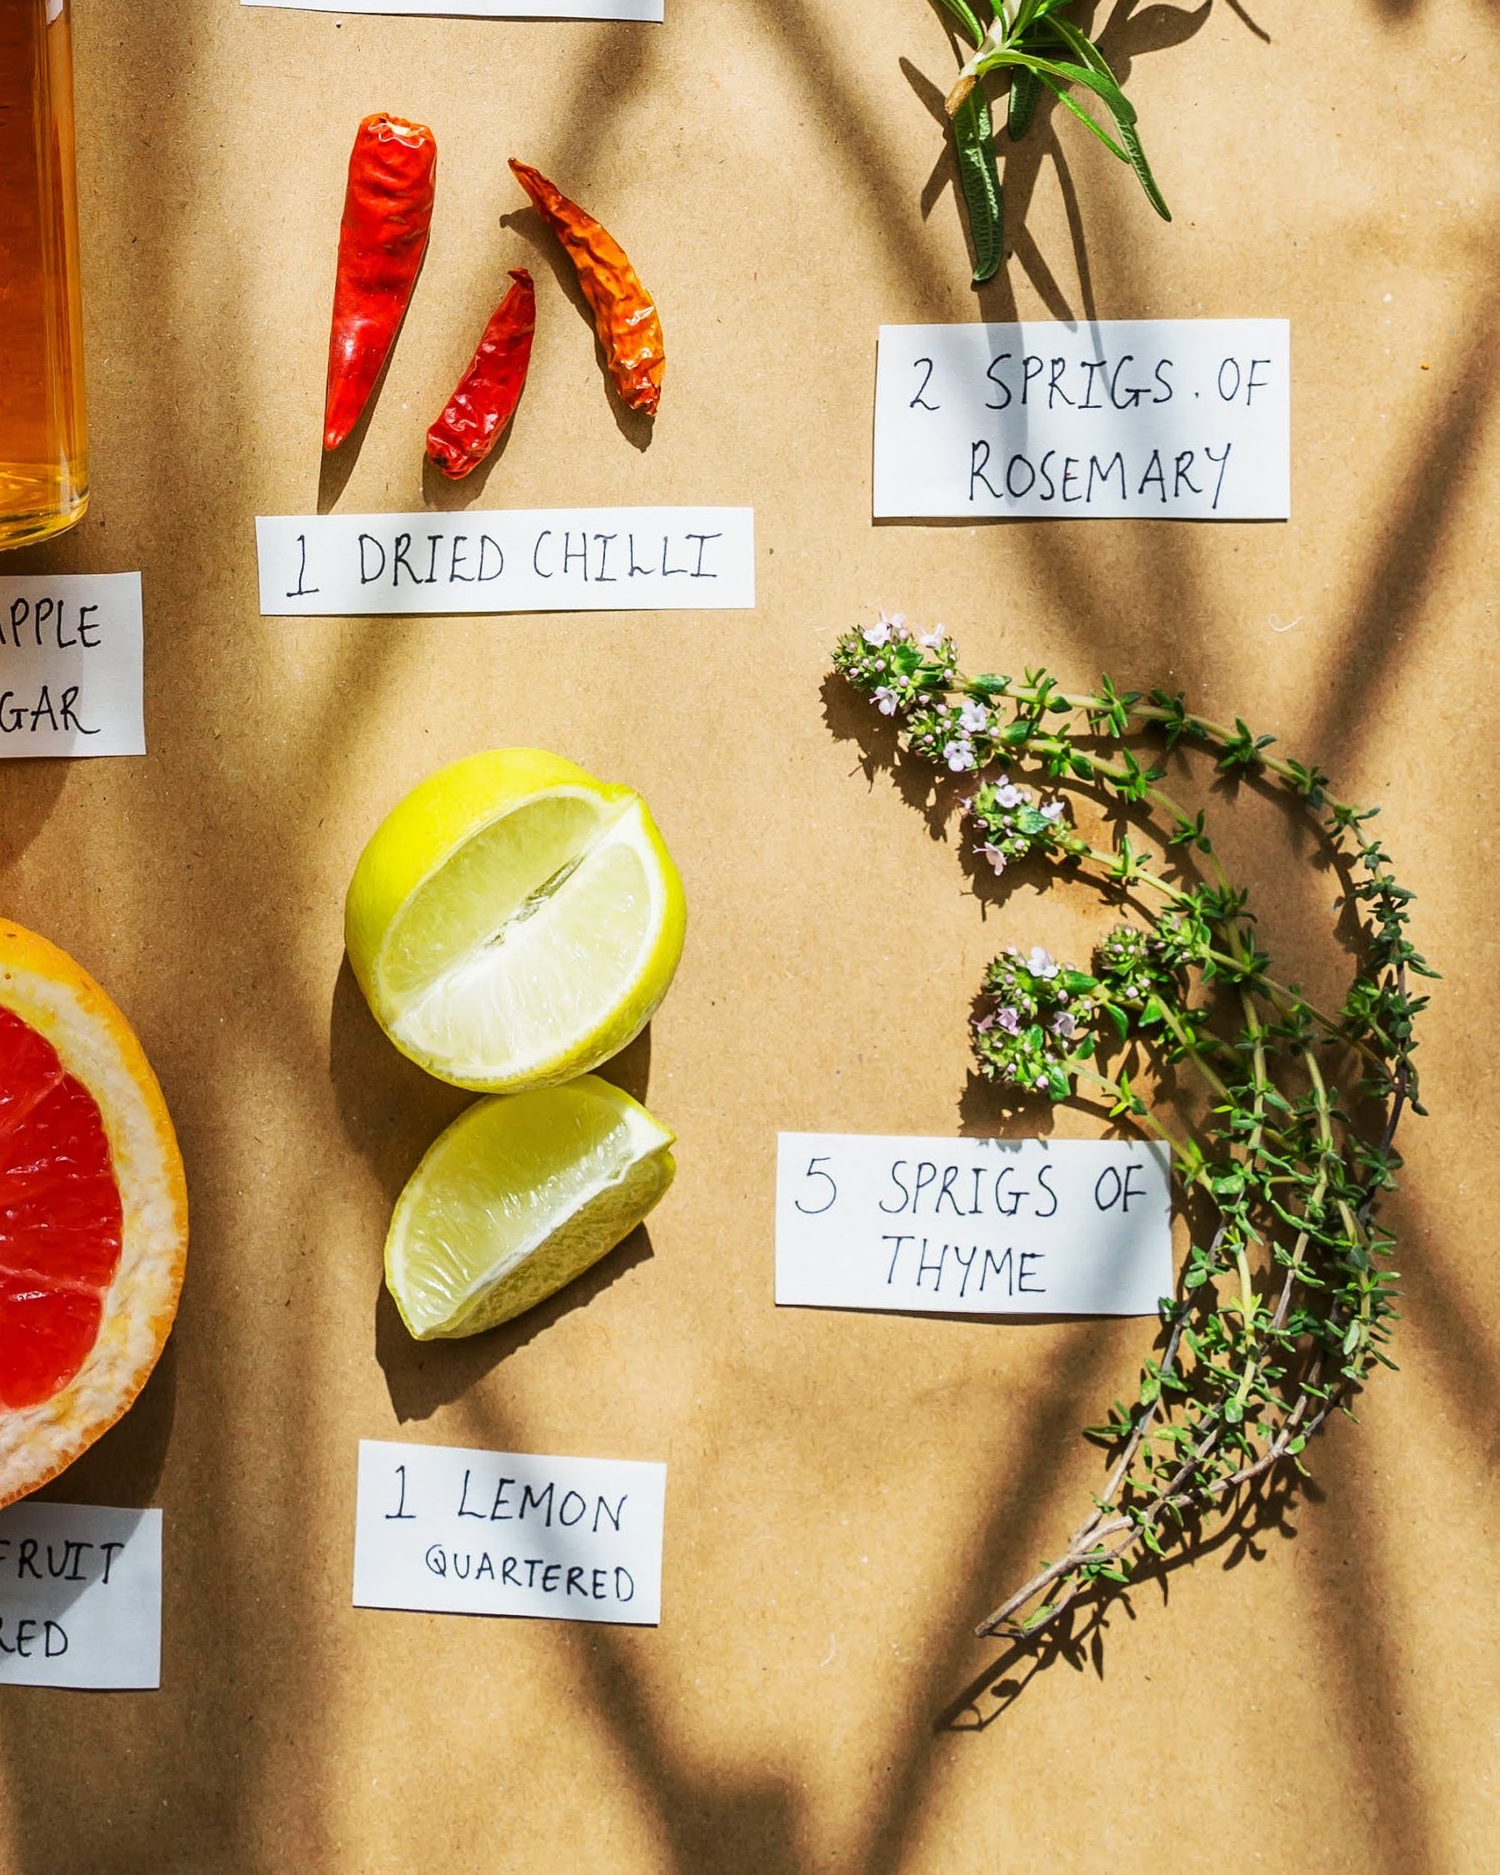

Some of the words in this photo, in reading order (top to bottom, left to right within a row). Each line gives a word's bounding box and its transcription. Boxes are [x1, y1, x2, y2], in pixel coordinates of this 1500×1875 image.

[909, 357, 941, 411] 2
[1217, 357, 1271, 407] OF
[968, 439, 1232, 510] ROSEMARY
[285, 534, 320, 598] 1
[357, 532, 504, 588] DRIED
[533, 530, 723, 582] CHILLI
[794, 1156, 837, 1215] 5
[878, 1160, 1058, 1218] SPRIGS
[1094, 1163, 1147, 1213] OF
[881, 1235, 1047, 1298] THYME
[384, 1464, 417, 1520] 1
[457, 1469, 628, 1533] LEMON
[425, 1543, 635, 1602] QUARTERED
